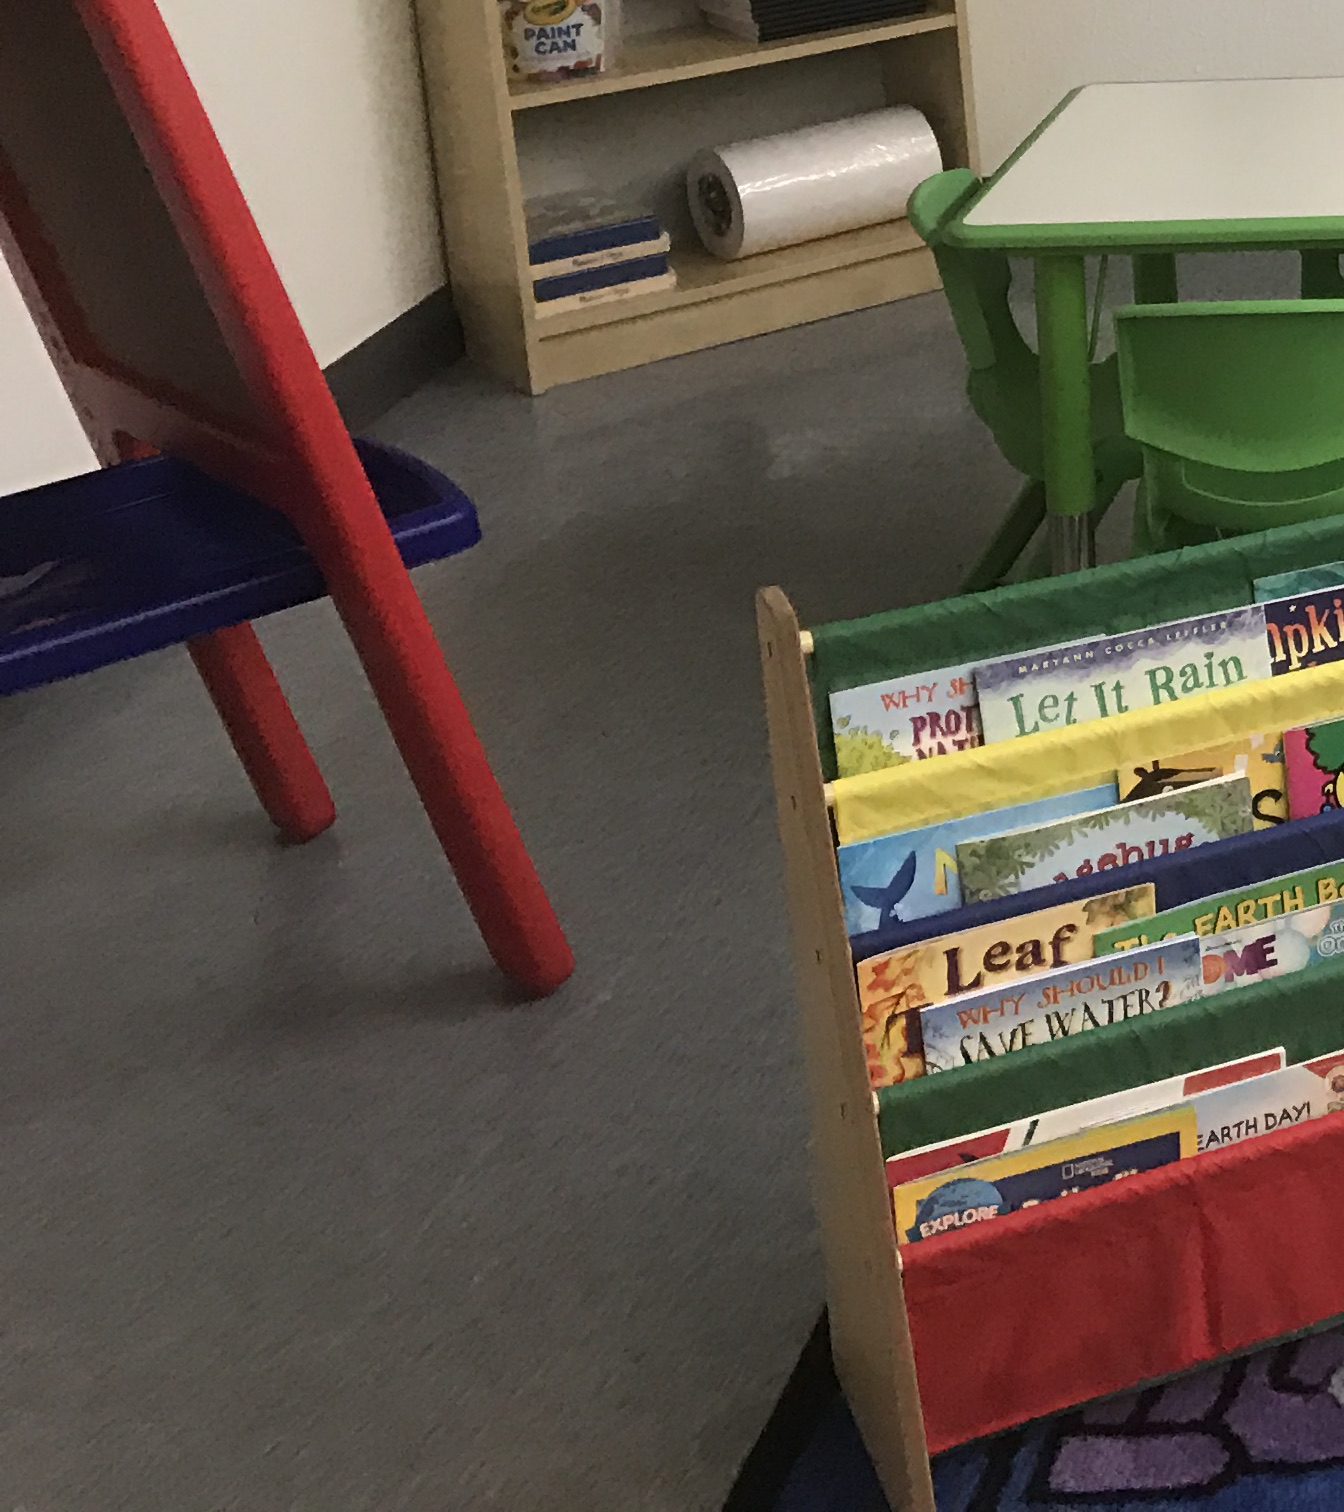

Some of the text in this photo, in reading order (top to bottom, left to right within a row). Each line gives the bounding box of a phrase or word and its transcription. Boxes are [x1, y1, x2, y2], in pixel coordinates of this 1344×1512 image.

[524, 23, 584, 41] PAINT
[534, 39, 577, 55] CAN
[1105, 637, 1155, 655] COCCA
[880, 682, 938, 711] WHY
[1007, 651, 1248, 737] Let It Rain
[1194, 886, 1304, 936] EARTH
[943, 923, 1078, 996] Leaf
[957, 956, 1165, 1030] WHY SHOULD I
[960, 980, 1172, 1065] SAVE WATER?
[1265, 1101, 1311, 1130] DAY!
[919, 1205, 998, 1237] EXPLORE
